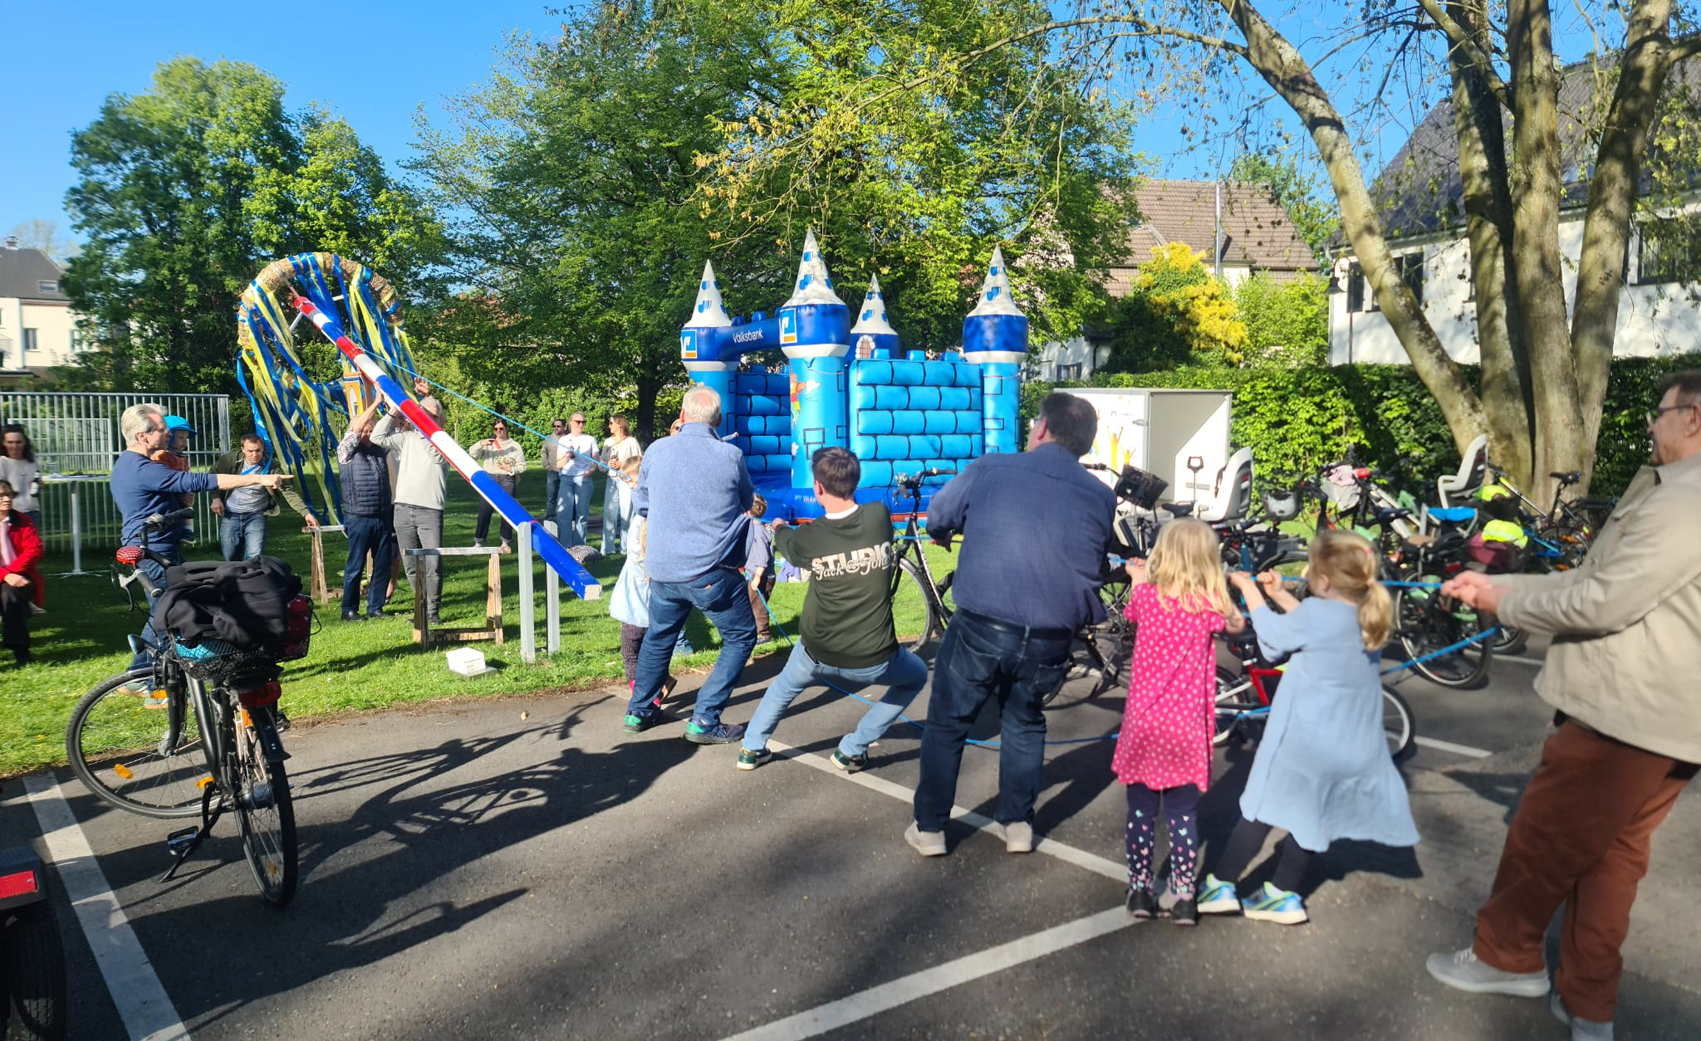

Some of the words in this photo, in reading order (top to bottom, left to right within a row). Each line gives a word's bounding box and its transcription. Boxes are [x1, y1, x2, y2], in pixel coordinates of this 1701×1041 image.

[732, 328, 763, 344] Volksbank
[812, 541, 891, 571] STUDIO
[814, 563, 845, 580] Jack
[860, 557, 891, 576] Jone
